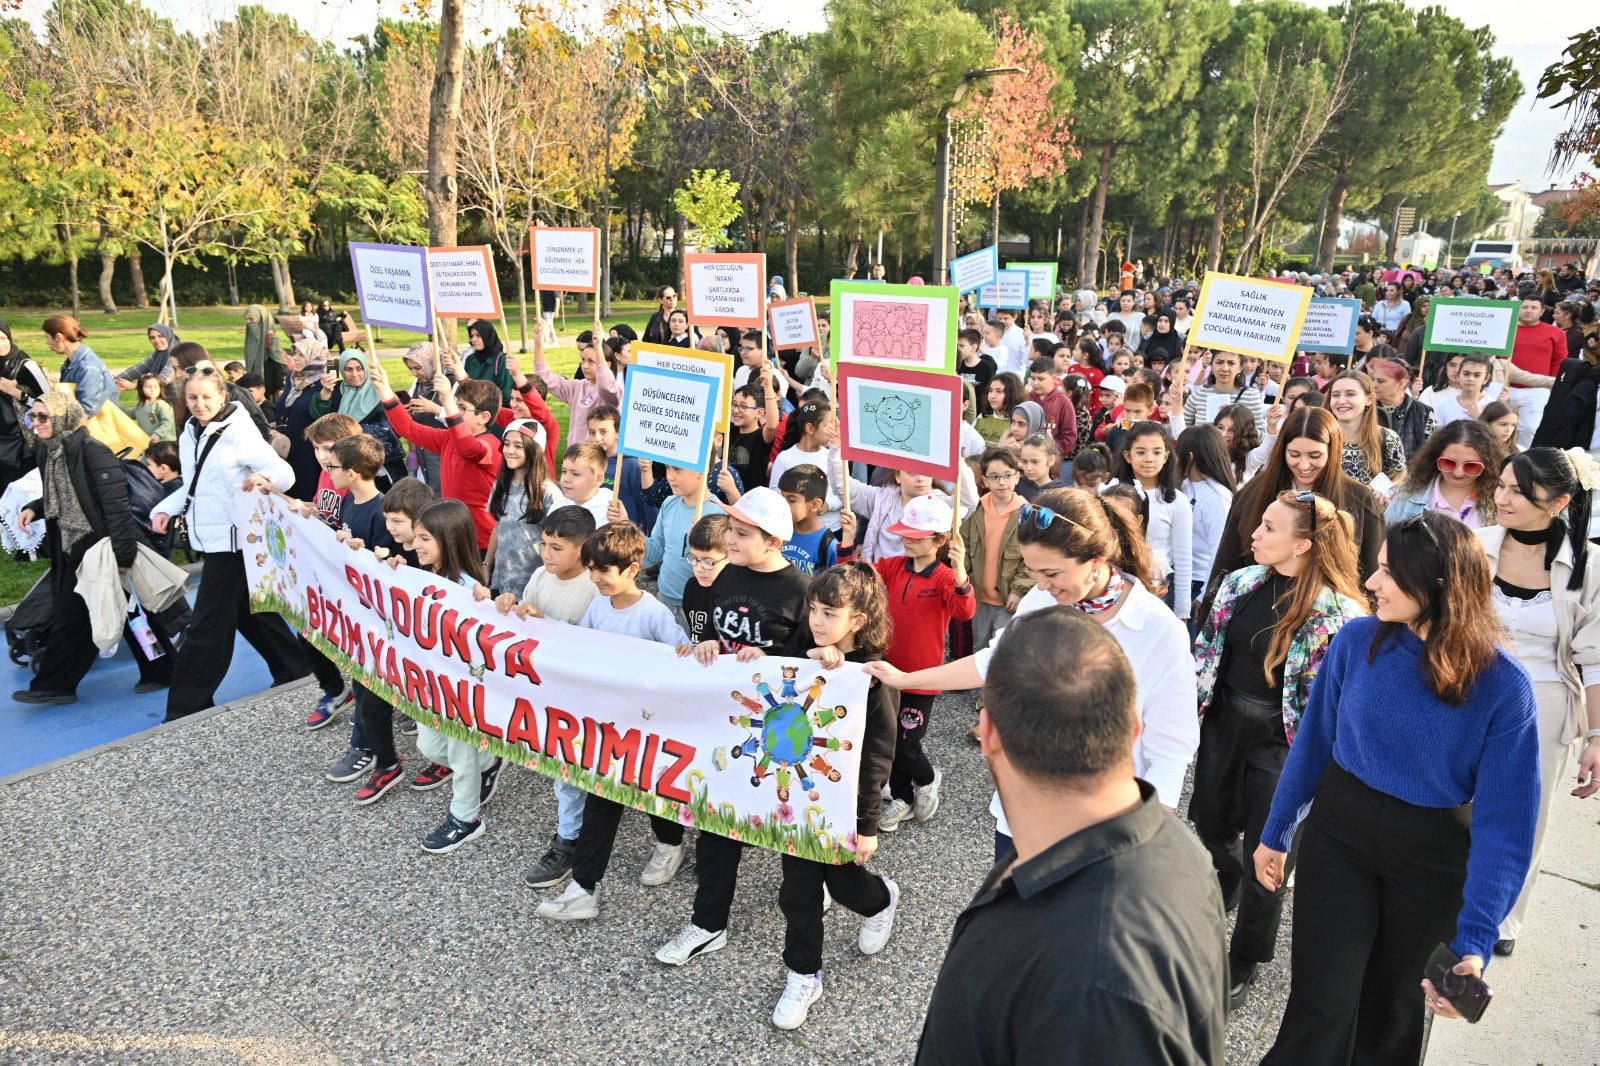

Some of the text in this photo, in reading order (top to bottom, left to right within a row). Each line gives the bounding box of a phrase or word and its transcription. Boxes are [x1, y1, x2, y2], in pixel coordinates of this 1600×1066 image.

[370, 264, 411, 277] ÖZEL YAŞAMIN
[715, 264, 743, 272] ÇOCUĞUN
[374, 280, 411, 292] GİZLİLİĞİ HER
[367, 293, 422, 308] ÇOCUĞUN HAKKIDIR.
[1240, 290, 1268, 301] SAĞLIK
[1217, 298, 1285, 317] HİZMETLERİNDEN
[1208, 311, 1287, 331] YARARLANMAK HER
[1203, 323, 1283, 344] ÇOCUĞUN HAKKIDIR.
[657, 360, 706, 374] HER ÇOCUĞUN
[642, 387, 696, 406] DÜŞÜNCELERİNİ
[633, 400, 701, 423] ÖZGÜRCE SÖYLEMEK
[639, 419, 689, 437] HER ÇOCUĞUN
[645, 436, 677, 451] HAKKIDIR.
[345, 563, 542, 686] BU DÜNYA
[307, 585, 697, 804] BİZİM YARINLARIMIZ
